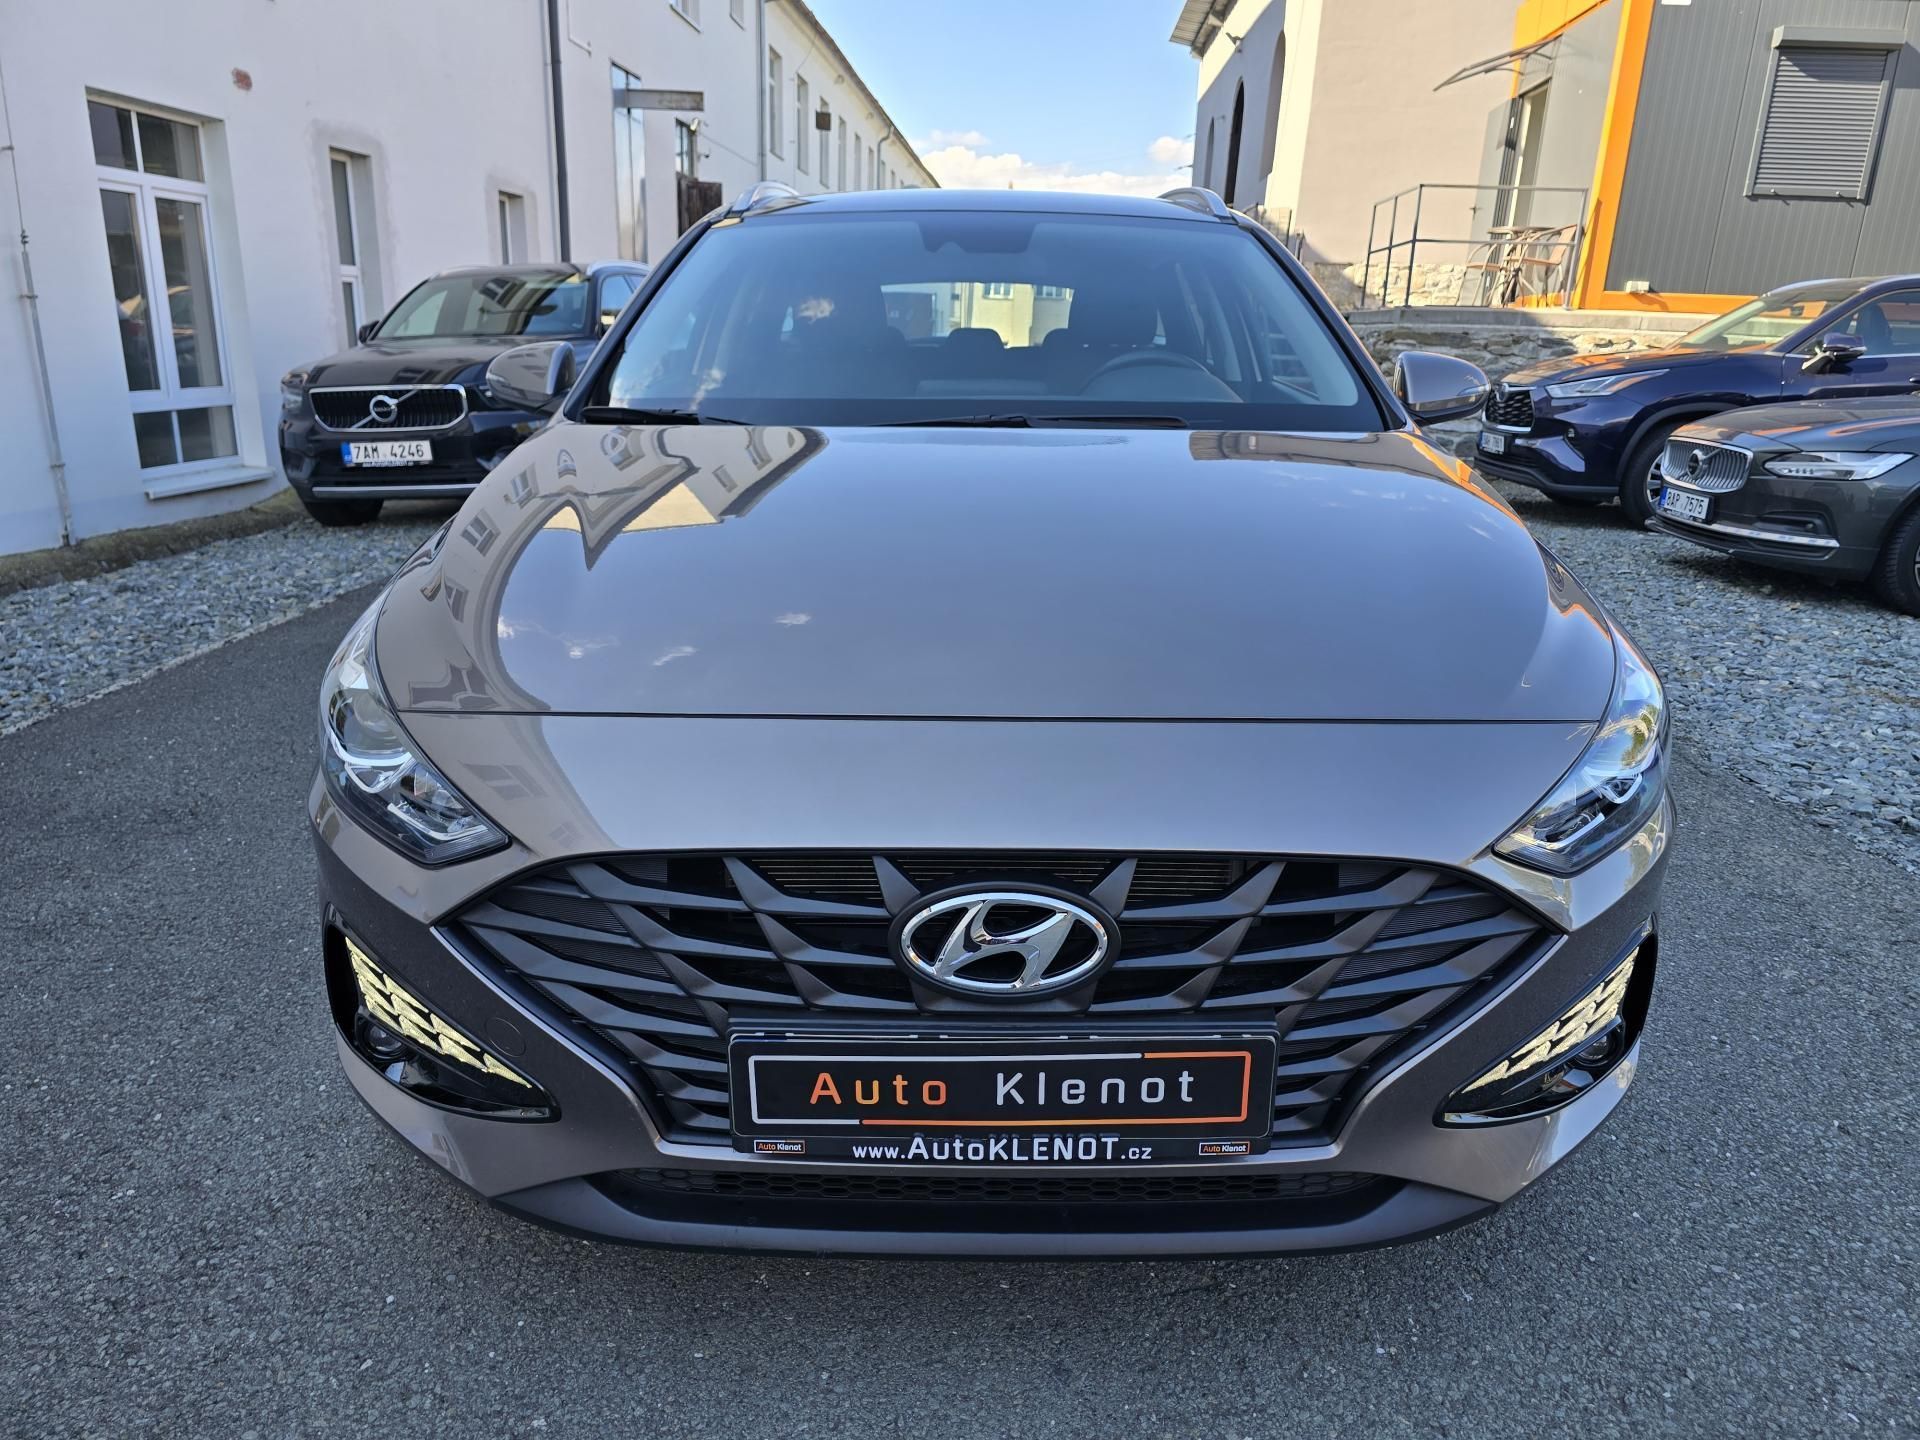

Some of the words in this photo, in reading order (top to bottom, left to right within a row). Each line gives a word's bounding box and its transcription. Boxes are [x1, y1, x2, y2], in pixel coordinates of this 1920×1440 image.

[353, 445, 380, 460] 7AM
[390, 444, 424, 458] 4246
[1684, 496, 1705, 514] 7575
[809, 1072, 948, 1105] Auto
[996, 1070, 1194, 1105] Klenot
[777, 1143, 801, 1151] Klenot
[852, 1136, 1152, 1161] www.AutoKLENOT.cz
